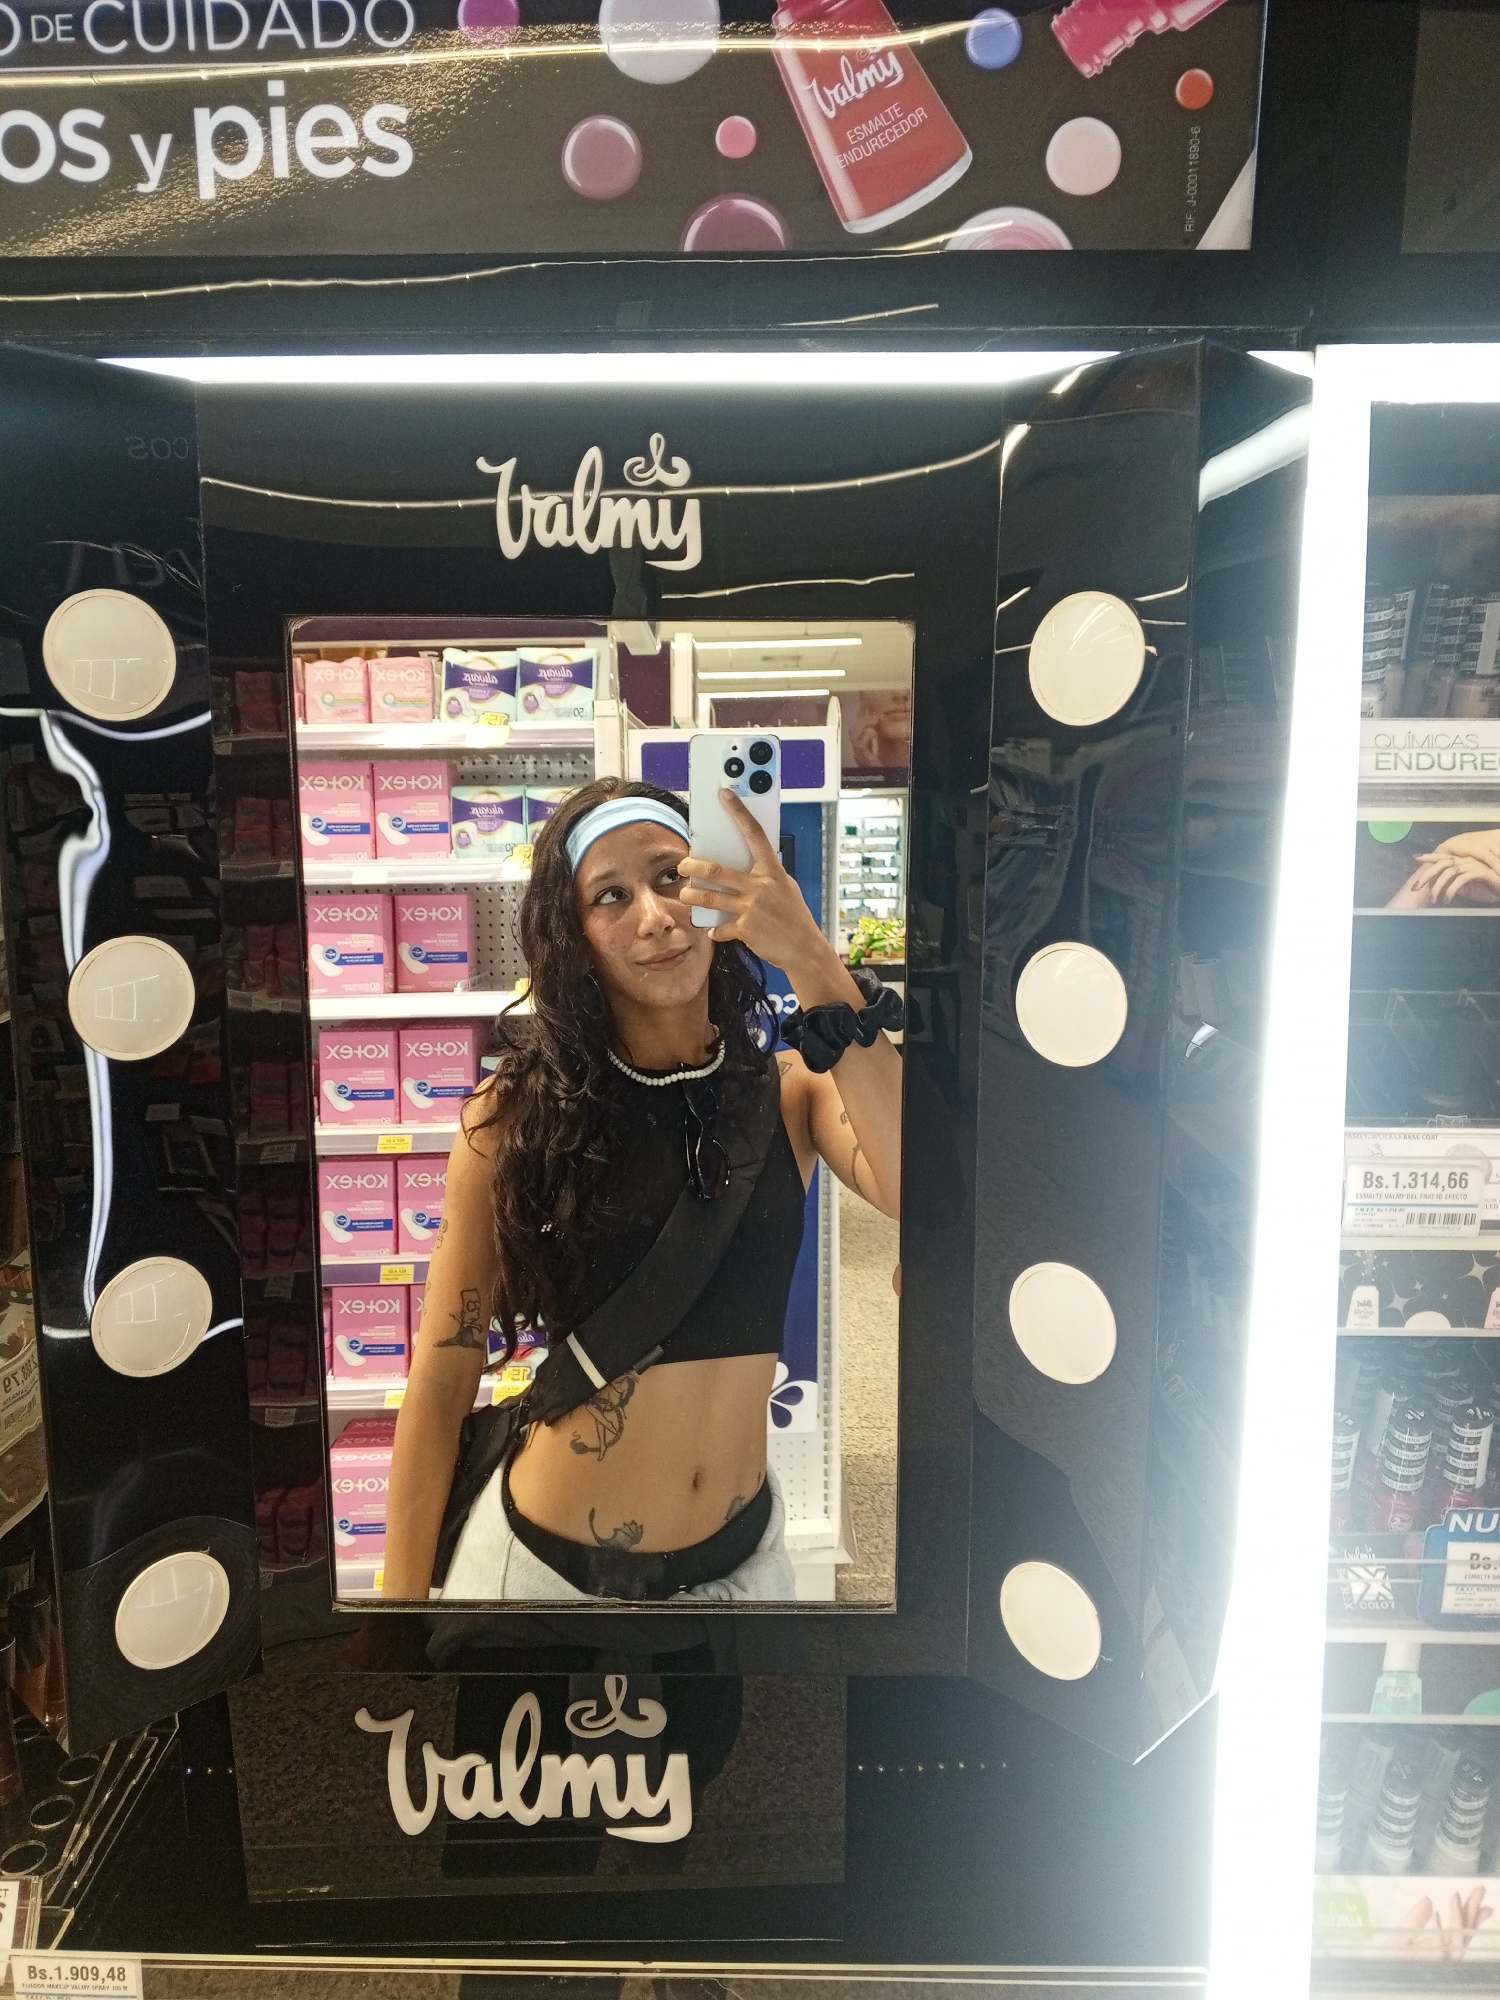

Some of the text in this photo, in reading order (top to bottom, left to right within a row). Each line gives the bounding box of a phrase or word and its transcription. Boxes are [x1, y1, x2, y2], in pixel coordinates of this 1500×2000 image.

[31, 15, 75, 43] DE
[82, 0, 414, 53] CUIDADO
[803, 51, 905, 119] Valmy
[131, 134, 172, 193] y
[194, 80, 415, 201] pies
[836, 107, 929, 169] ENDURECEDOR
[846, 102, 904, 145] ESMALTE
[476, 432, 700, 572] Valmy
[1374, 731, 1480, 750] QUÍMICAS
[1375, 753, 1500, 771] ENDURE
[1363, 1171, 1469, 1192] Bs.1.314,66
[1448, 1513, 1500, 1533] NU
[1470, 1552, 1500, 1570] Bs.
[355, 1675, 692, 1844] Valmy
[27, 1965, 126, 1984] Bs.1.909,48
